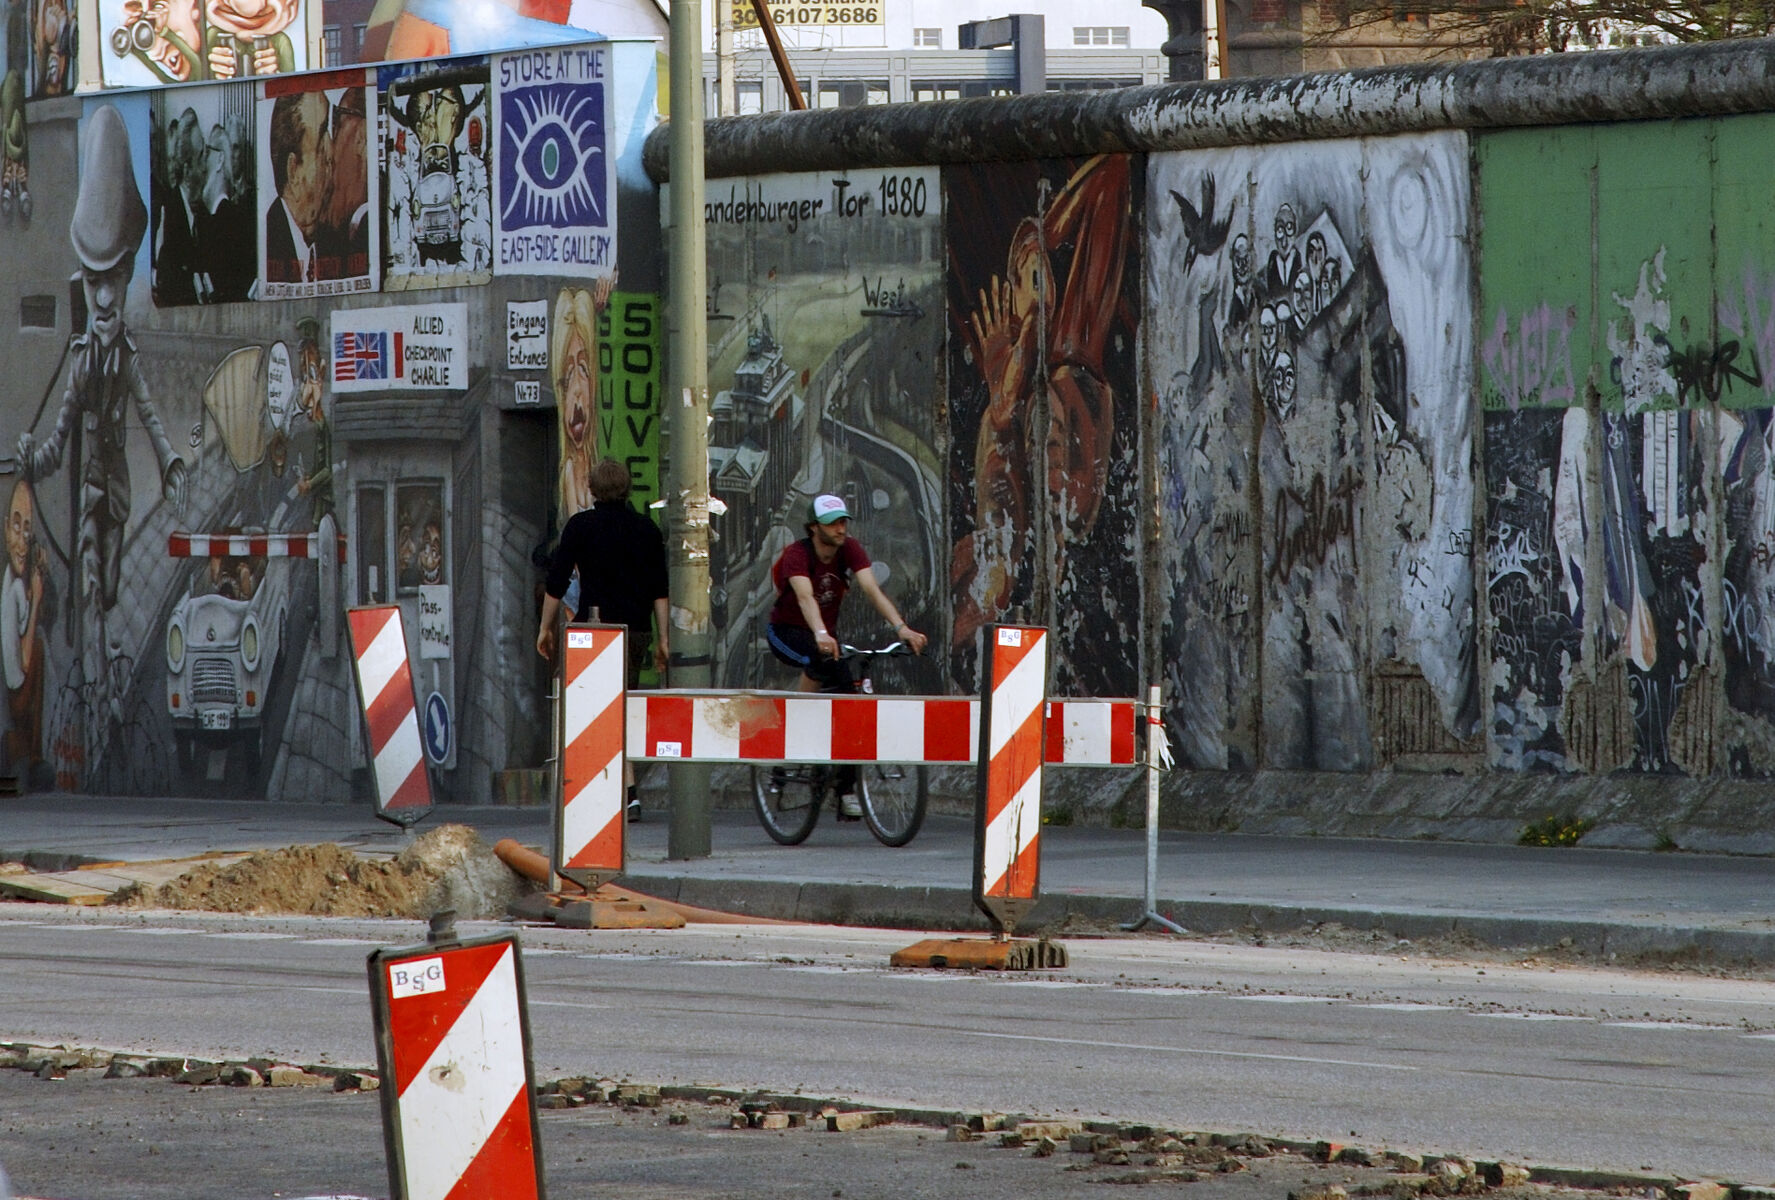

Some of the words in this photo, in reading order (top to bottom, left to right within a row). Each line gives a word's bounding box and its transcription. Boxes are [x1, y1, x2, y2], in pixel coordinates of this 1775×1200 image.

[773, 8, 822, 24] 6107
[827, 7, 878, 24] 3686
[500, 52, 552, 88] STORE
[555, 50, 573, 79] AT
[576, 50, 605, 79] THE
[705, 182, 823, 234] andenburger
[832, 179, 870, 218] Tor
[878, 175, 927, 218] 1980
[501, 234, 559, 265] EAST-SIDE
[562, 235, 611, 267] GALLERY
[862, 276, 905, 309] West
[413, 315, 444, 335] ALLIED
[509, 310, 547, 335] Eingang
[404, 345, 453, 363] CHECKPOINT
[509, 346, 547, 366] Entrance
[411, 367, 450, 386] CHARLIE
[570, 634, 591, 645] BSG
[1001, 630, 1020, 643] BSG
[394, 965, 441, 992] BSG
